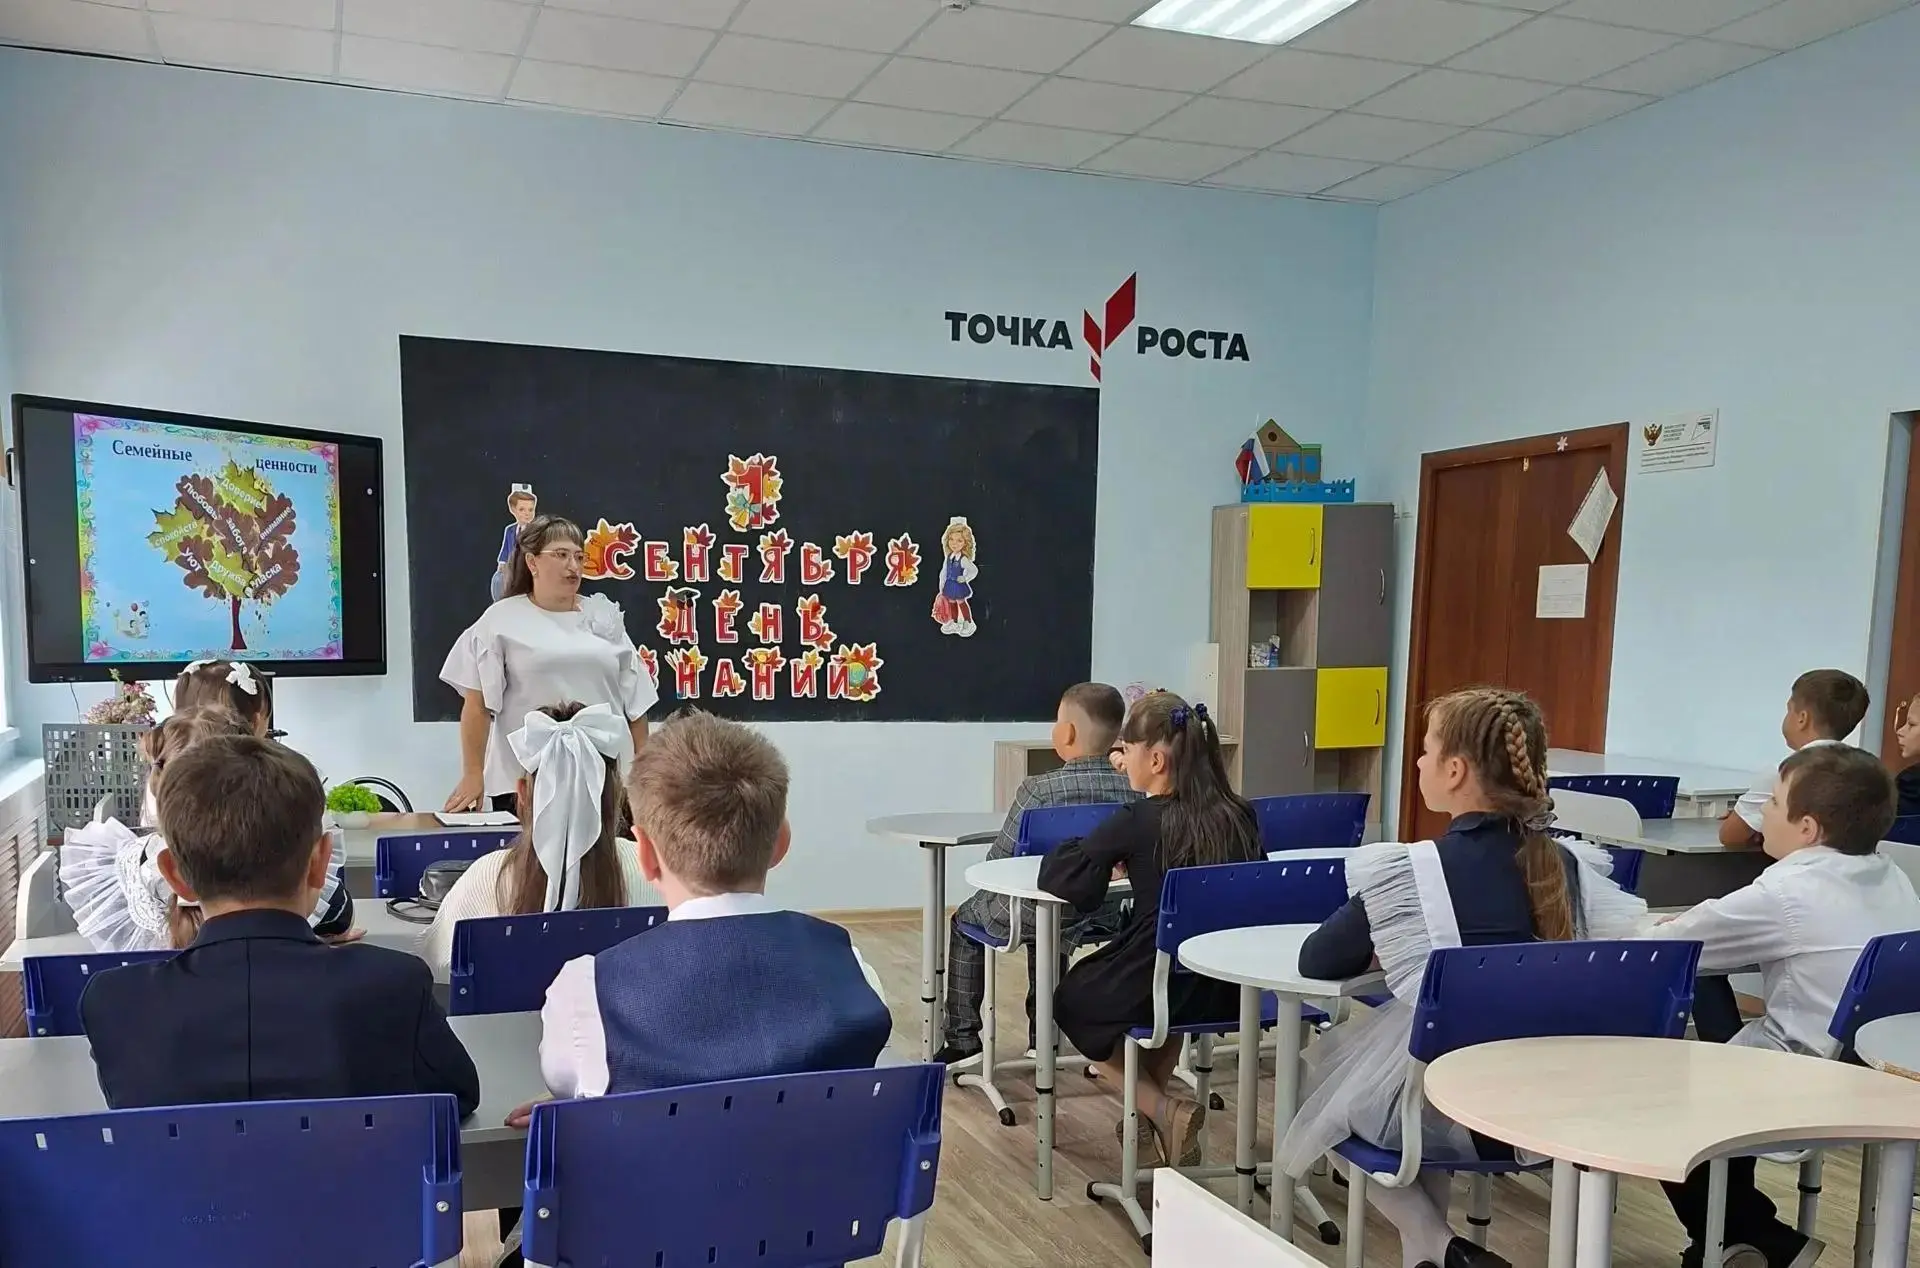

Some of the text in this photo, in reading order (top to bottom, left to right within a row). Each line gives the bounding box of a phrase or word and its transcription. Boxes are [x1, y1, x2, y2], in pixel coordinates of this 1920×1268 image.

[944, 311, 1250, 361] ТОЧКА РОСТА
[112, 439, 318, 475] Семейные ценности
[183, 482, 219, 520] Любовь
[604, 539, 912, 586] СЕНТЯБРЯ
[672, 600, 824, 646] ДЕНЬ
